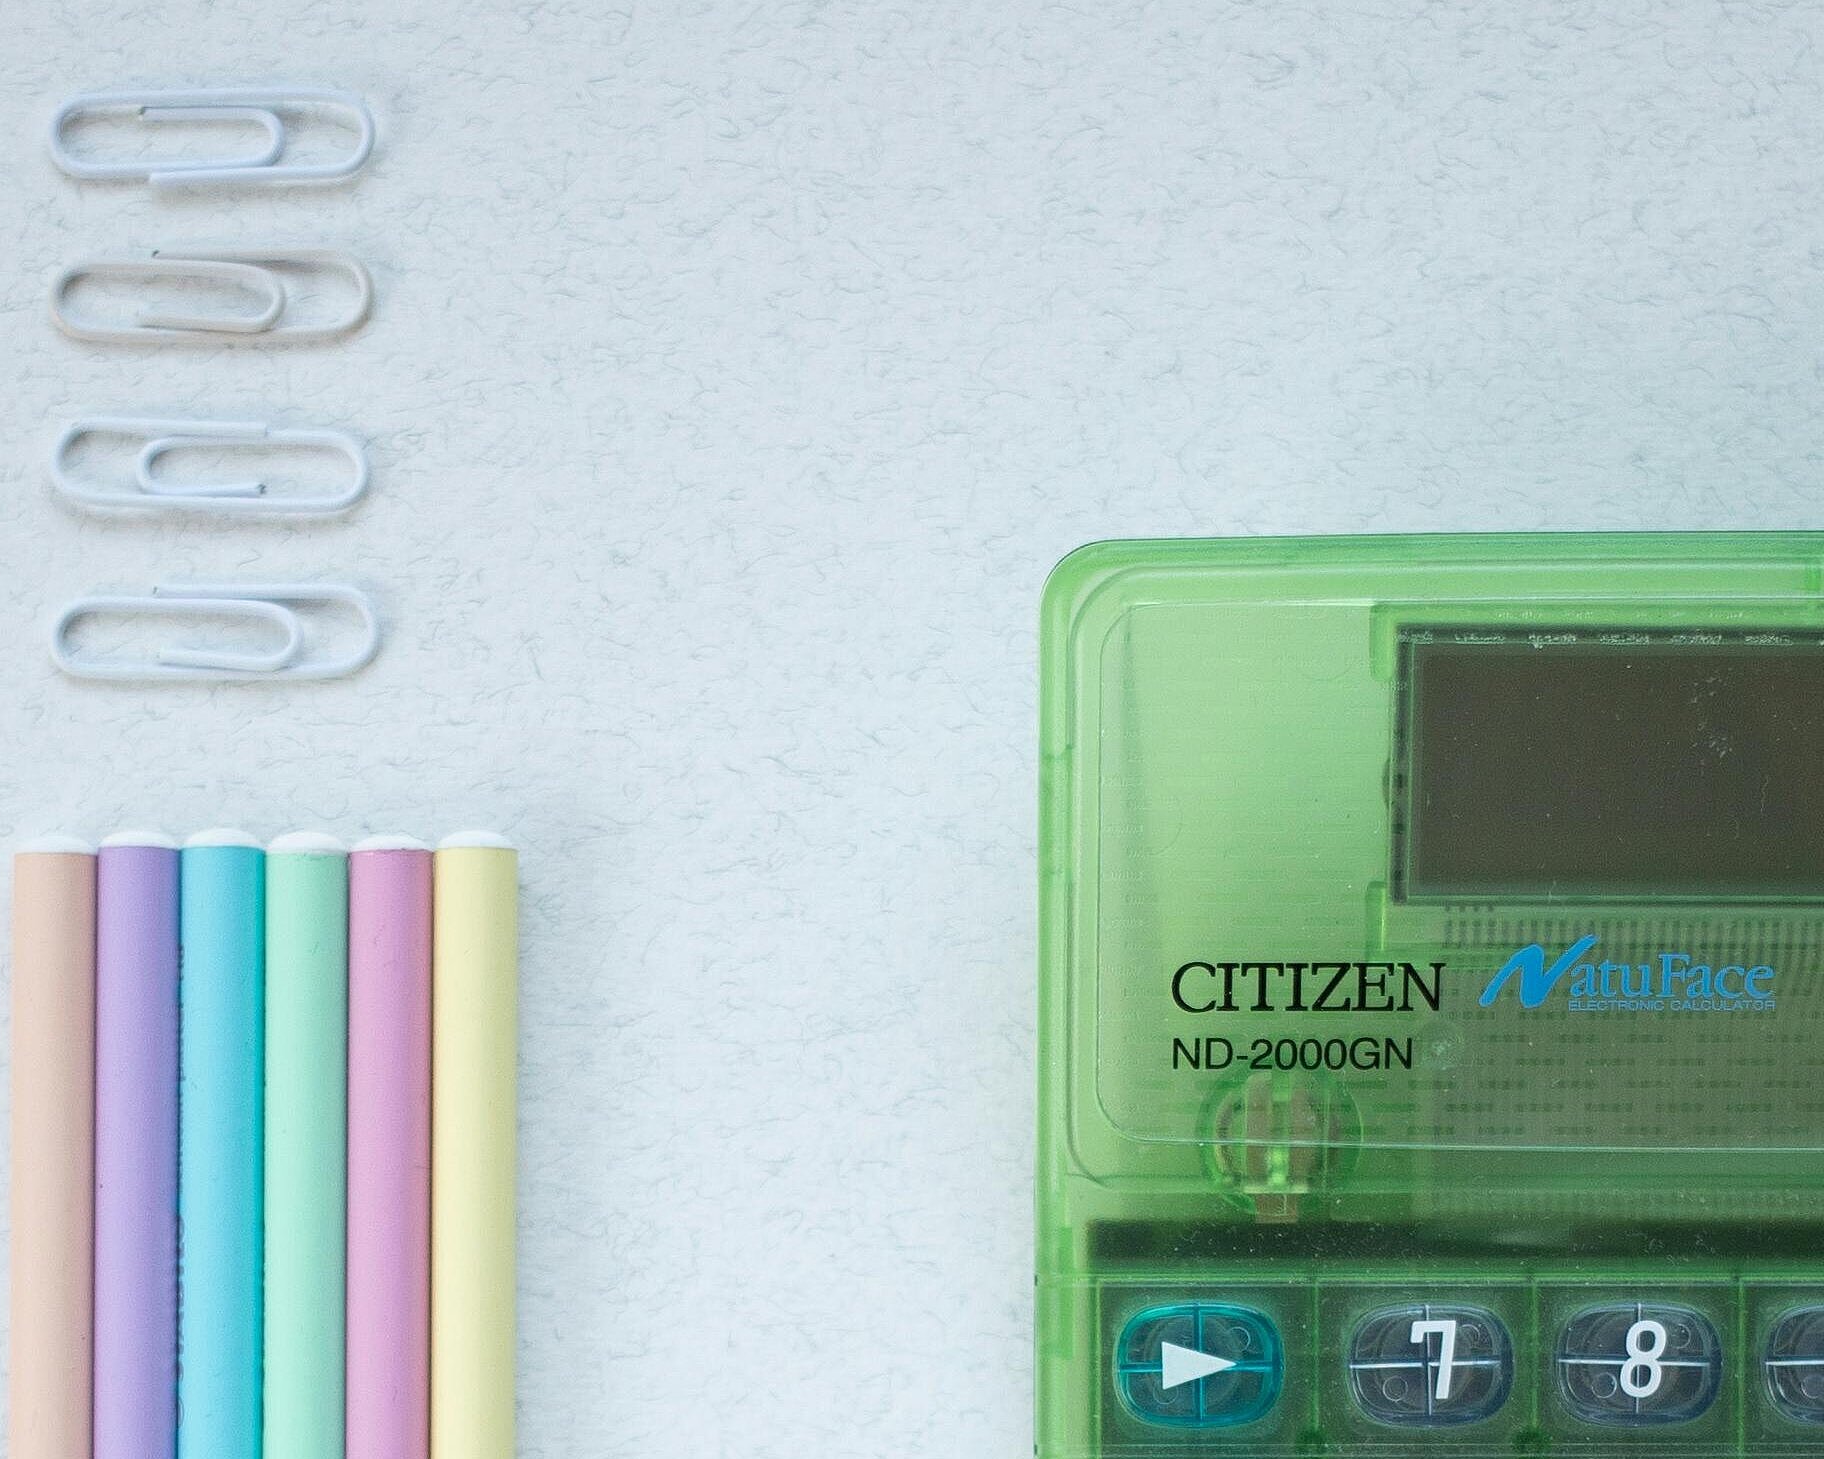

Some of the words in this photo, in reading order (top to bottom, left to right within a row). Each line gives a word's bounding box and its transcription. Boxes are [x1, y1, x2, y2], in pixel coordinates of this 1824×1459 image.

[1171, 961, 1446, 1014] CITIZEN
[1479, 933, 1776, 1009] NatuFace
[1567, 999, 1665, 1012] ELECTRONIC
[1669, 999, 1777, 1012] CALCULATOR
[1171, 1036, 1413, 1071] ND-2000GN
[1409, 1319, 1457, 1401] 7
[1616, 1321, 1666, 1400] 8
